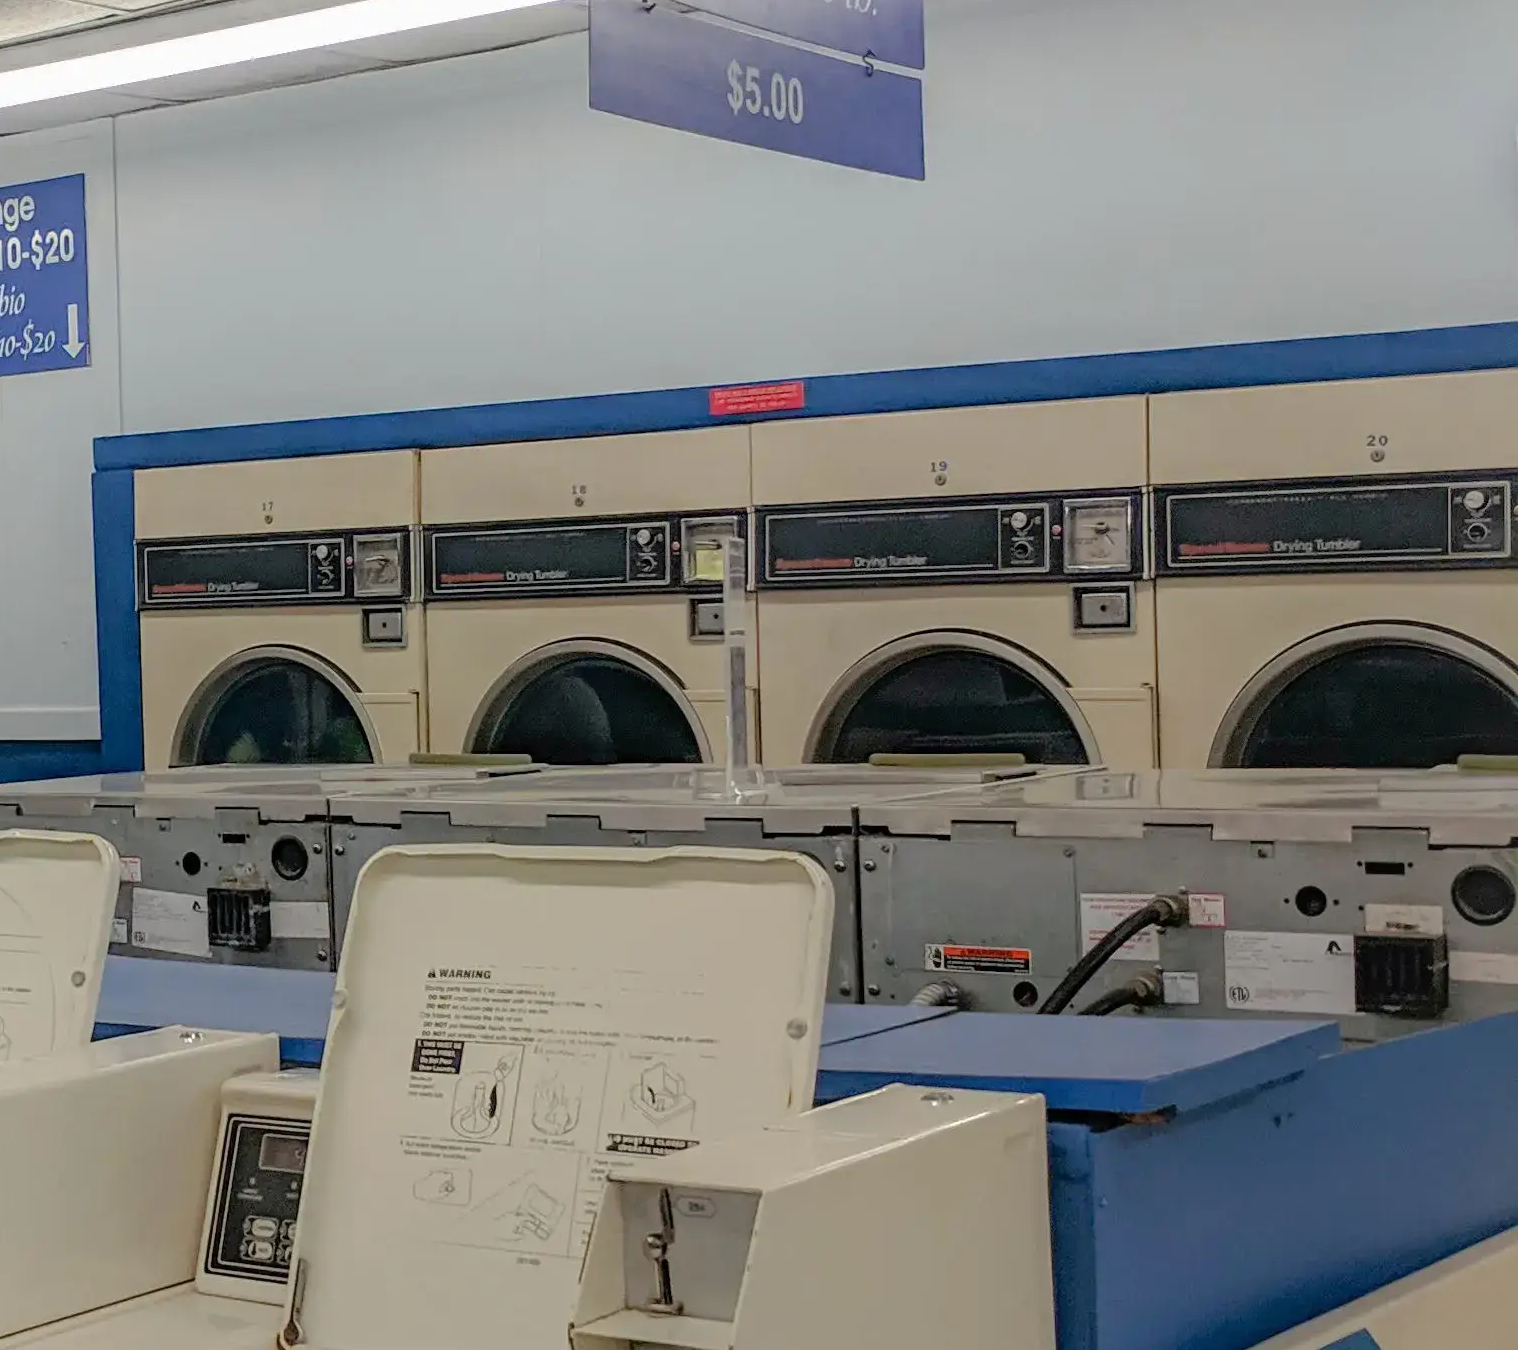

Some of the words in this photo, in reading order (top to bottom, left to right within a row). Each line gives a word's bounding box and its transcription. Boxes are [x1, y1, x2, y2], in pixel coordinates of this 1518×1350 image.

[727, 59, 803, 124] $5.00
[1366, 434, 1388, 447] 20
[930, 461, 947, 472] 19
[572, 485, 587, 495] 18
[262, 501, 274, 511] 17
[1274, 539, 1312, 552] Drying
[439, 969, 491, 979] WARNING
